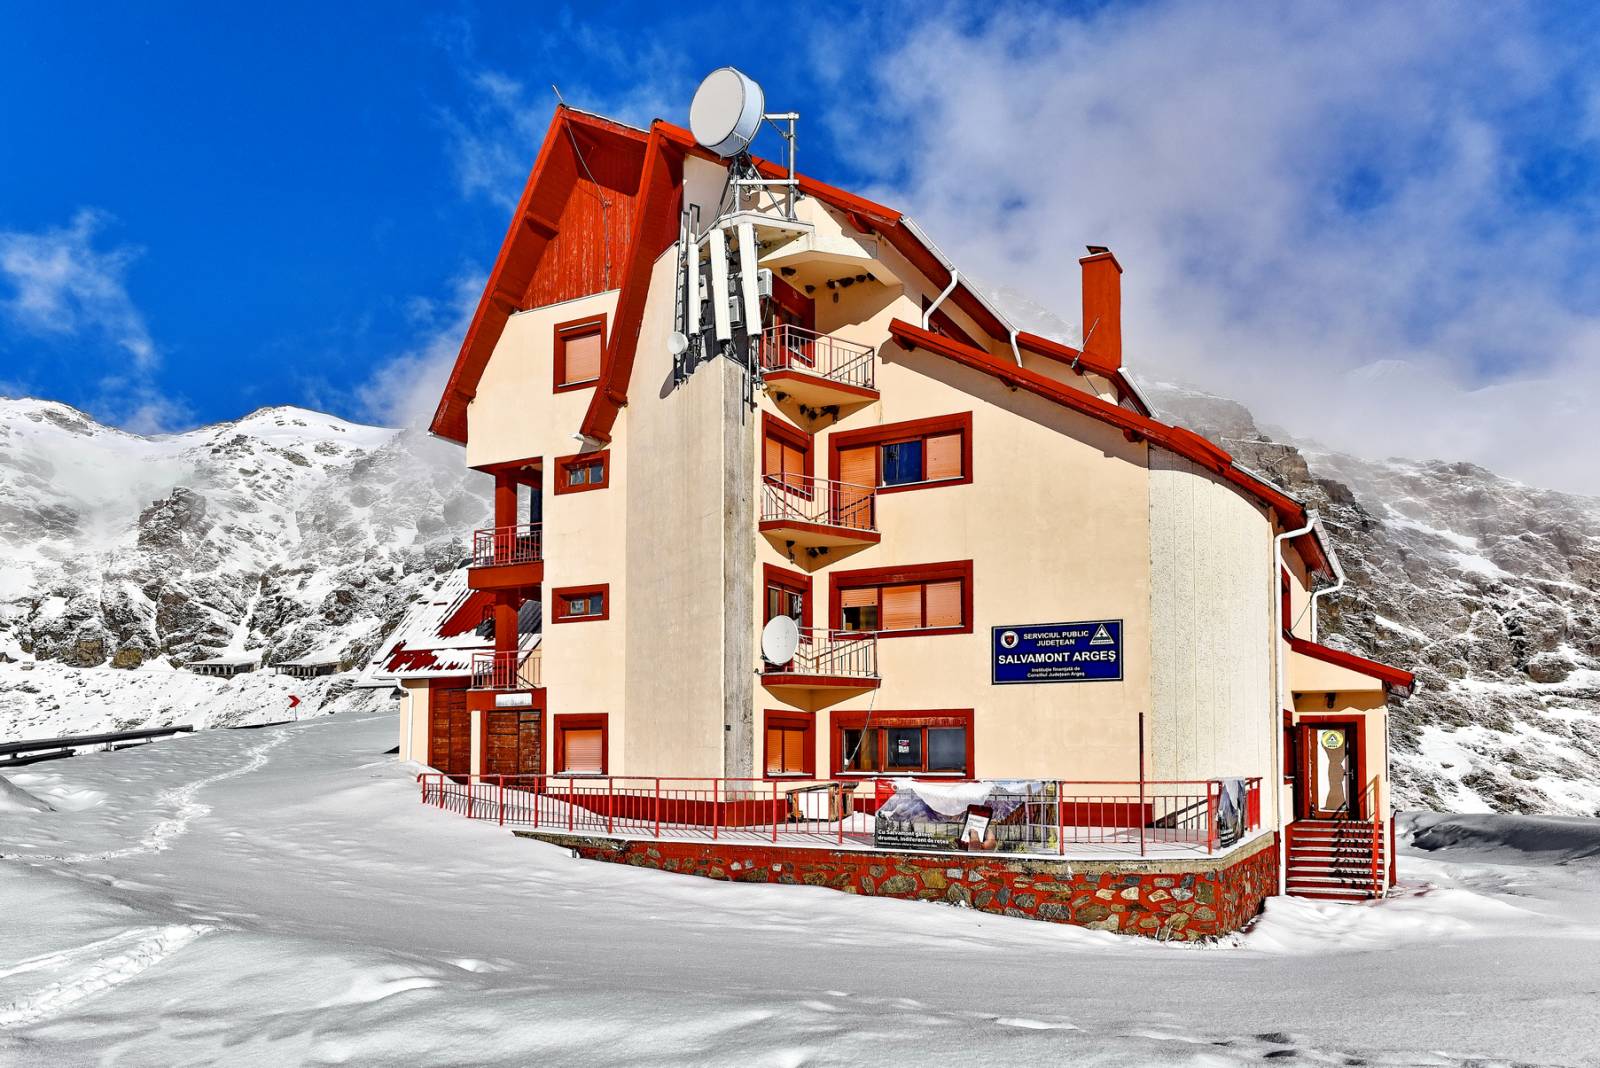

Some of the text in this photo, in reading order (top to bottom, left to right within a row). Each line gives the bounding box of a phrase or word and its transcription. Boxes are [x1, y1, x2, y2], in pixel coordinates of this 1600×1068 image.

[1023, 630, 1089, 640] SERVICIUL PUBLIC
[998, 652, 1070, 664] SALVAMONT
